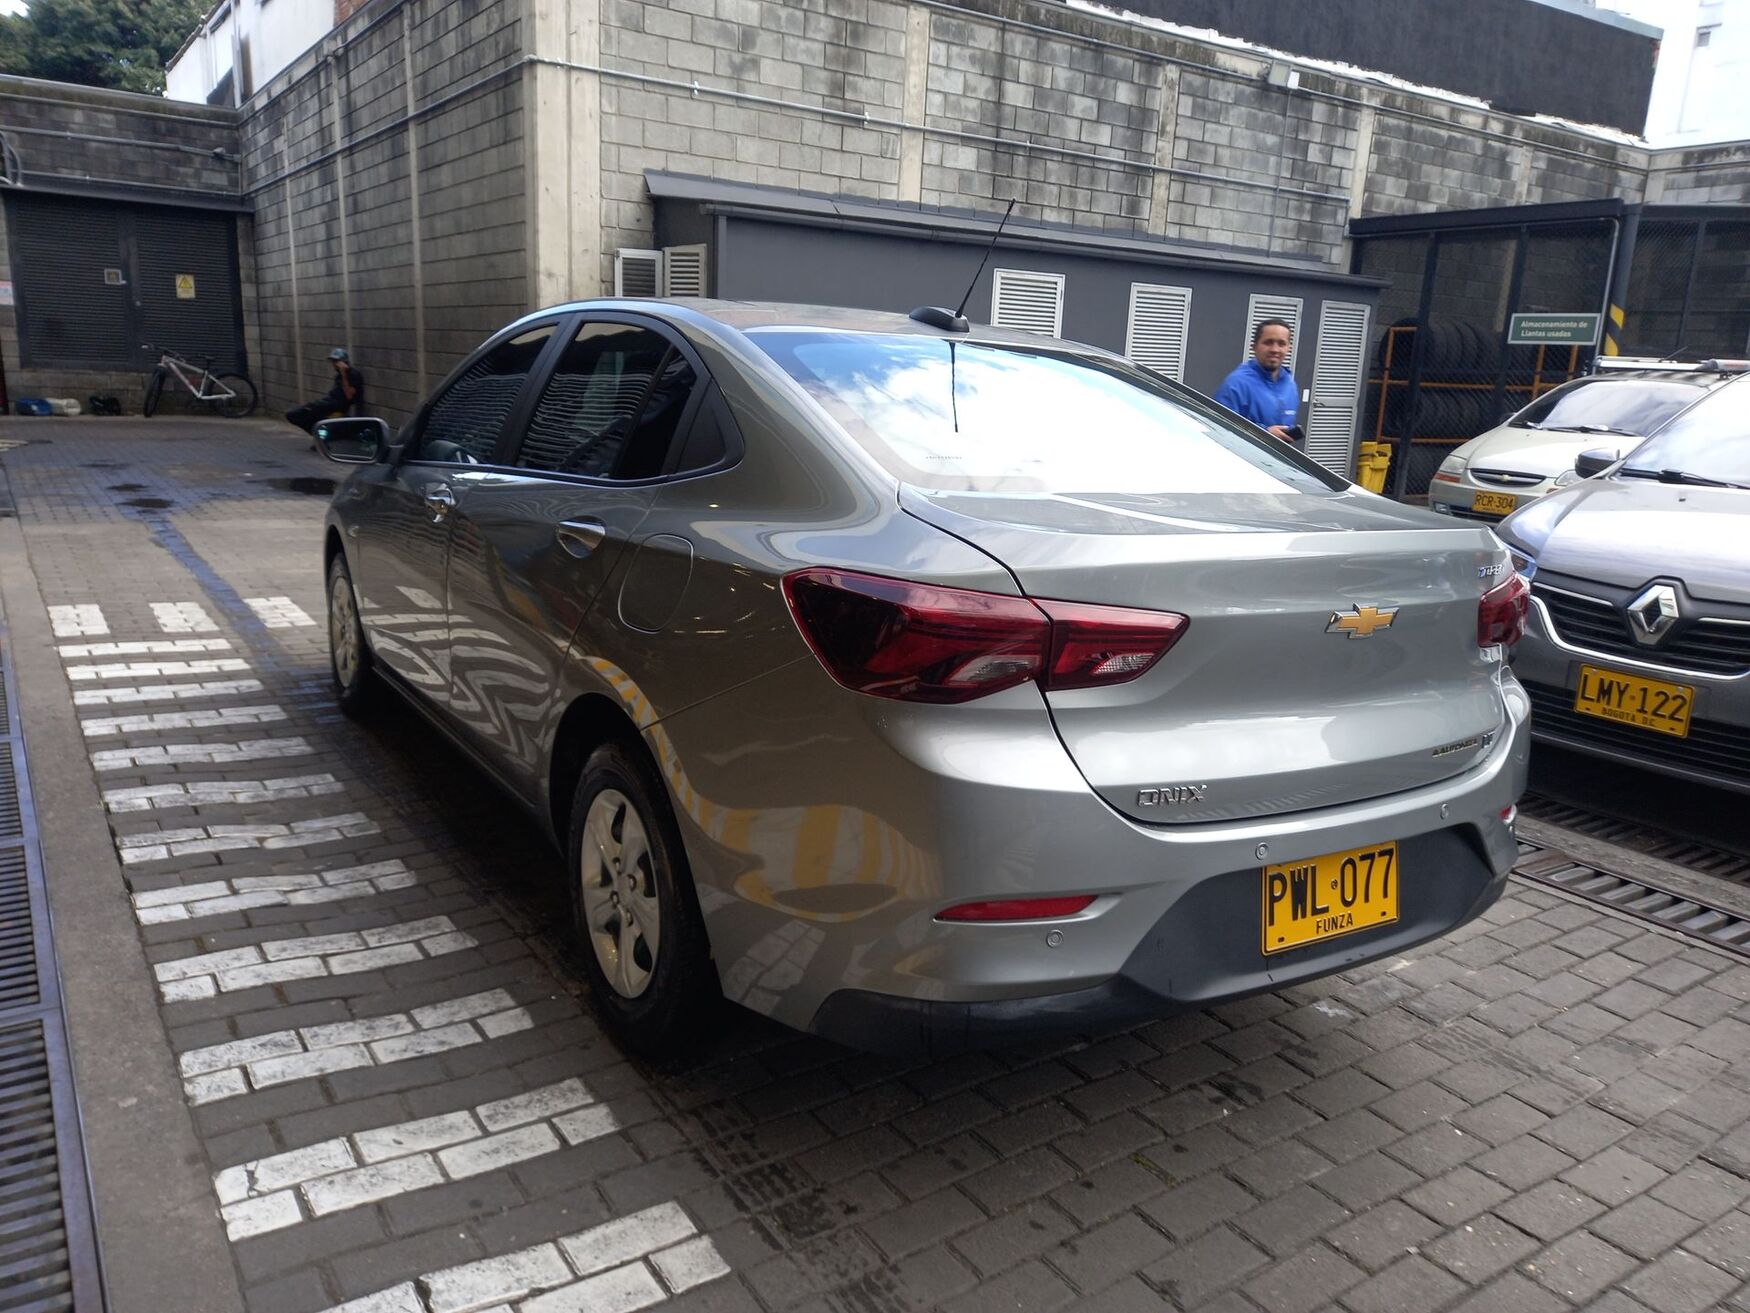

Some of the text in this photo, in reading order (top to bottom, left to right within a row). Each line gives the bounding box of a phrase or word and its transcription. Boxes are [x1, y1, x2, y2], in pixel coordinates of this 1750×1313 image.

[1520, 320, 1588, 329] Almacenamiento de
[1520, 329, 1546, 337] Llantas
[1138, 784, 1207, 807] ONIX
[1268, 847, 1394, 927] PWL 077
[1316, 912, 1353, 934] FUNZA
